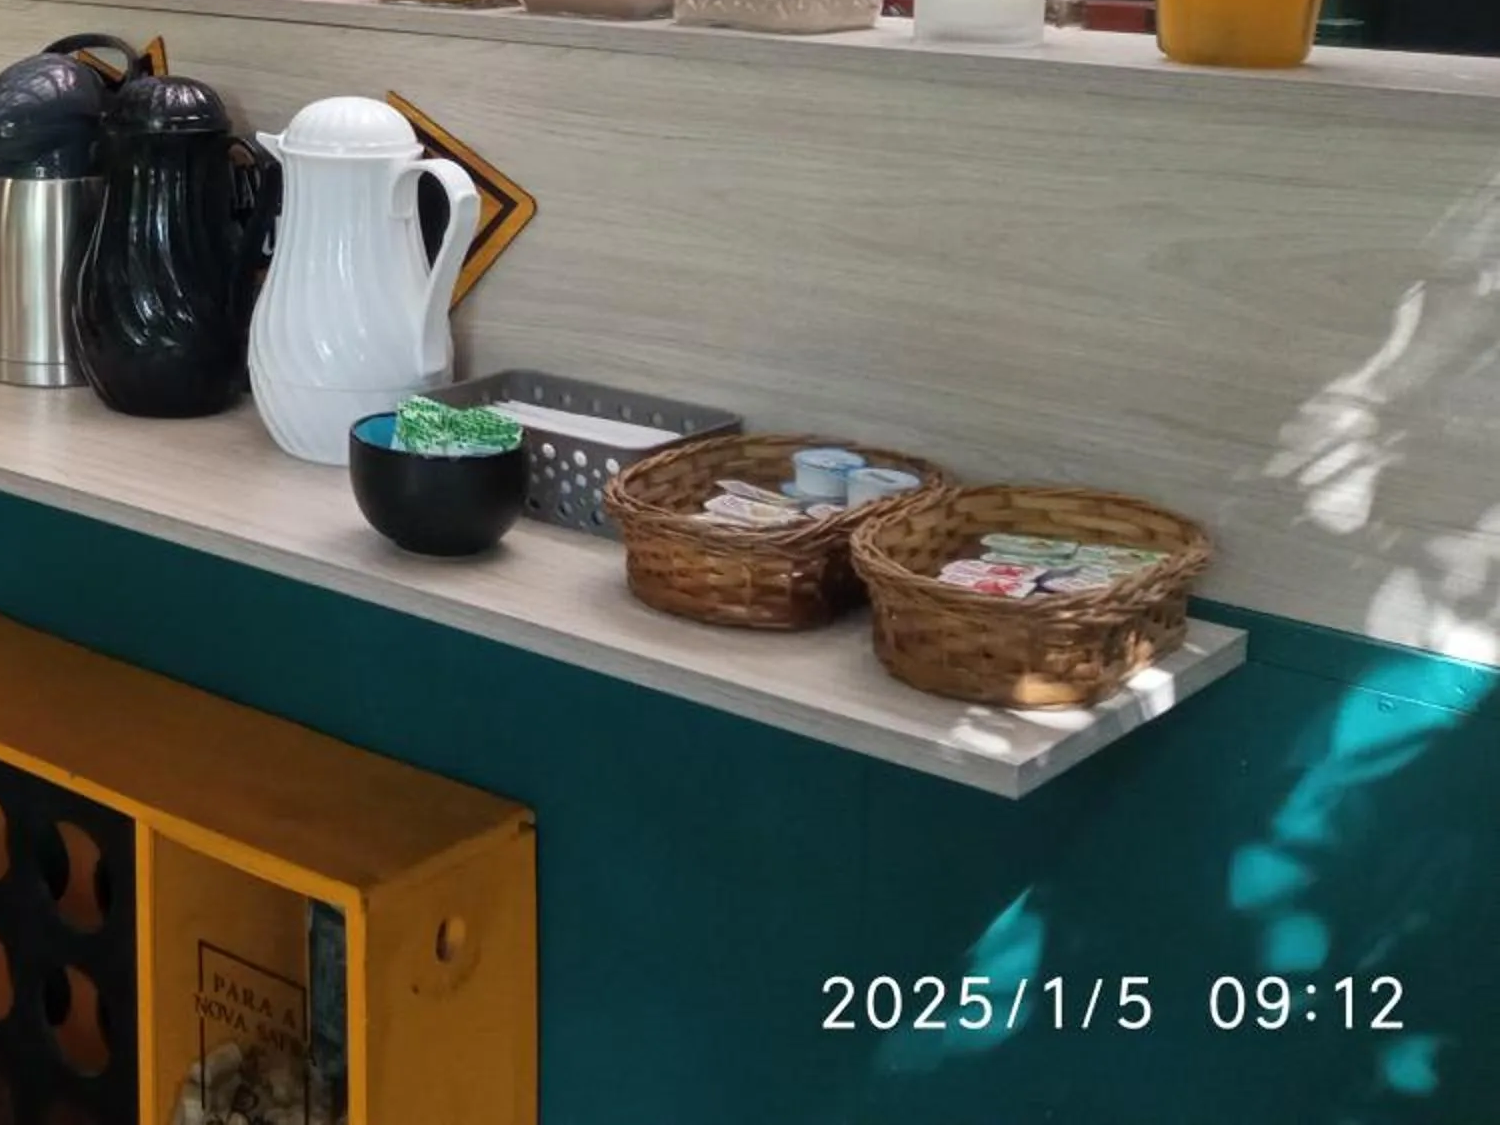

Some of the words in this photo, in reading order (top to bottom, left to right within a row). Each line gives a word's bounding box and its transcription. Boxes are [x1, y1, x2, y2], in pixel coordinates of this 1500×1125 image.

[193, 992, 247, 1032] NOVA
[213, 972, 273, 1018] PARA
[283, 1008, 296, 1030] A
